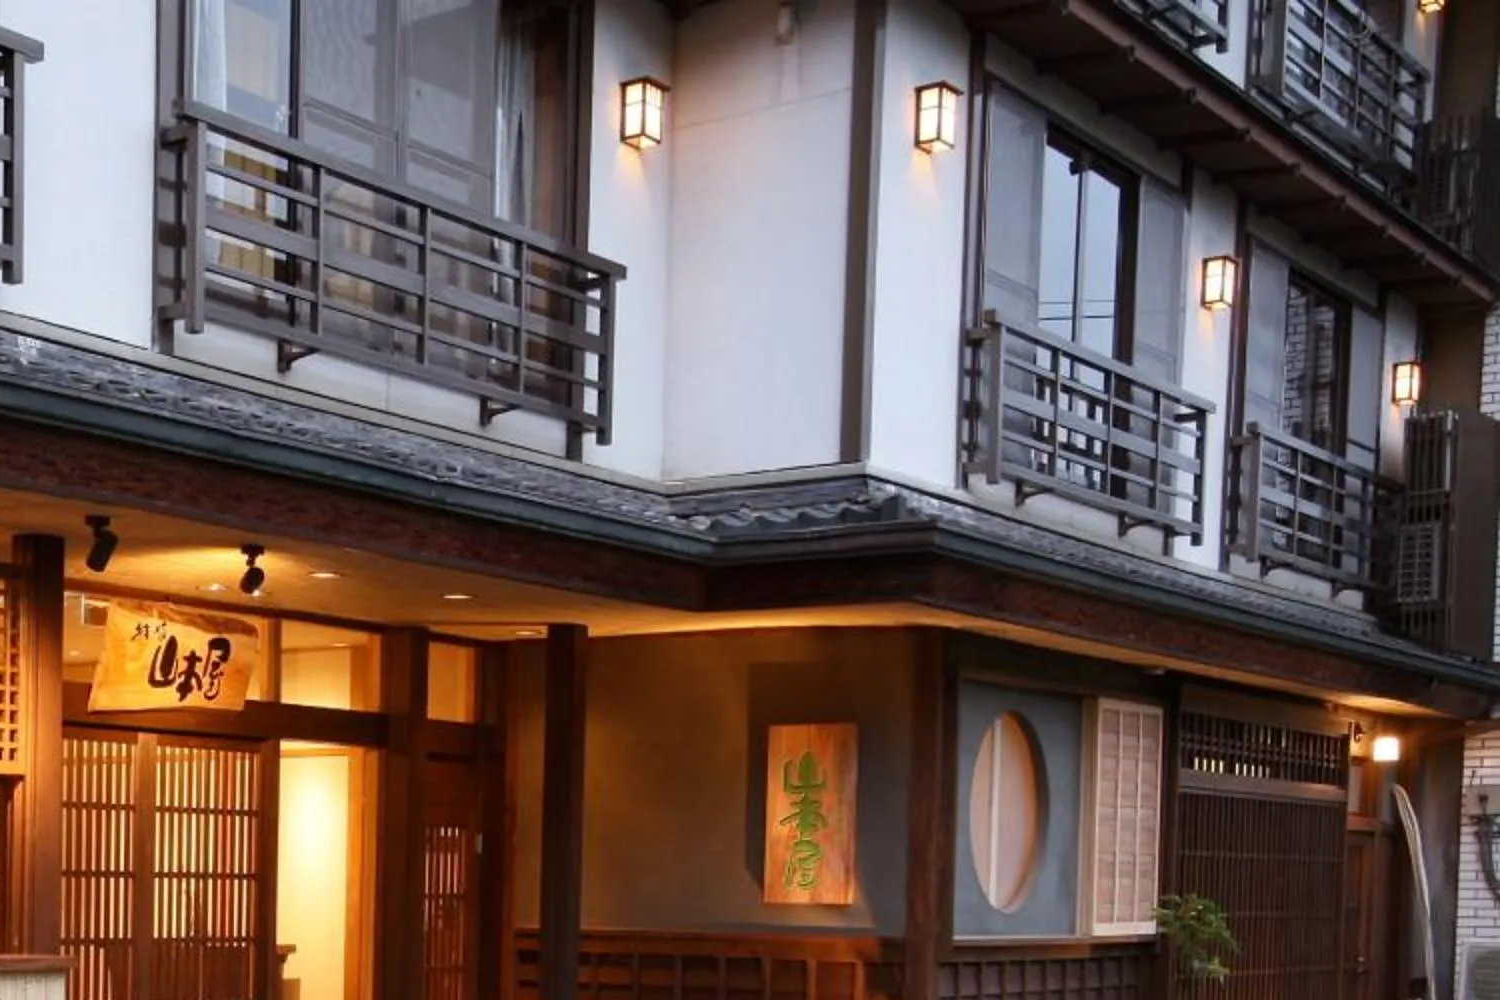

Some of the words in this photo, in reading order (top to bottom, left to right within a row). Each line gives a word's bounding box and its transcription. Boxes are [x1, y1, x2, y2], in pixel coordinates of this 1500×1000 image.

[147, 635, 231, 702] 山本屋
[778, 750, 828, 892] 山本屋
